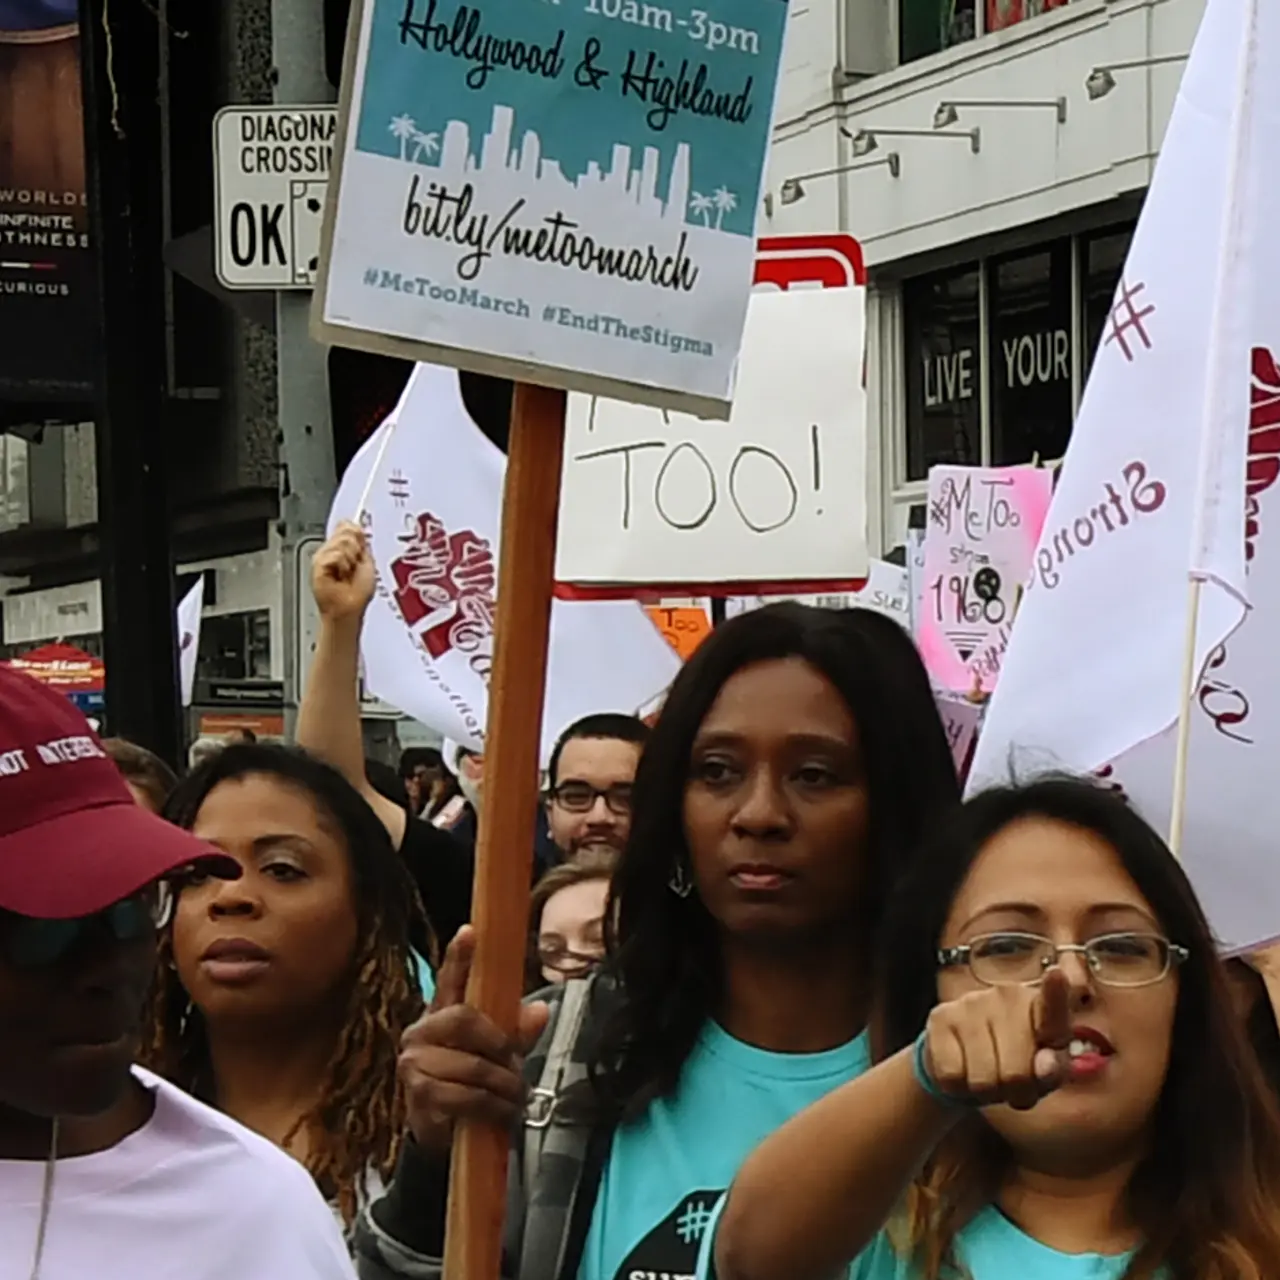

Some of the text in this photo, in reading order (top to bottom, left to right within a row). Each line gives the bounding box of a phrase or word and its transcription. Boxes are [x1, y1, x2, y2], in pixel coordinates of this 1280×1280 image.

[397, 0, 753, 131] Hollywood & Highland
[230, 202, 287, 267] OK
[403, 174, 699, 292] bit.ly/metoomarch
[362, 266, 714, 358] #MeTooMarch #EndTheStigma
[923, 329, 1069, 407] LIVE YOUR
[574, 424, 824, 533] TOO!
